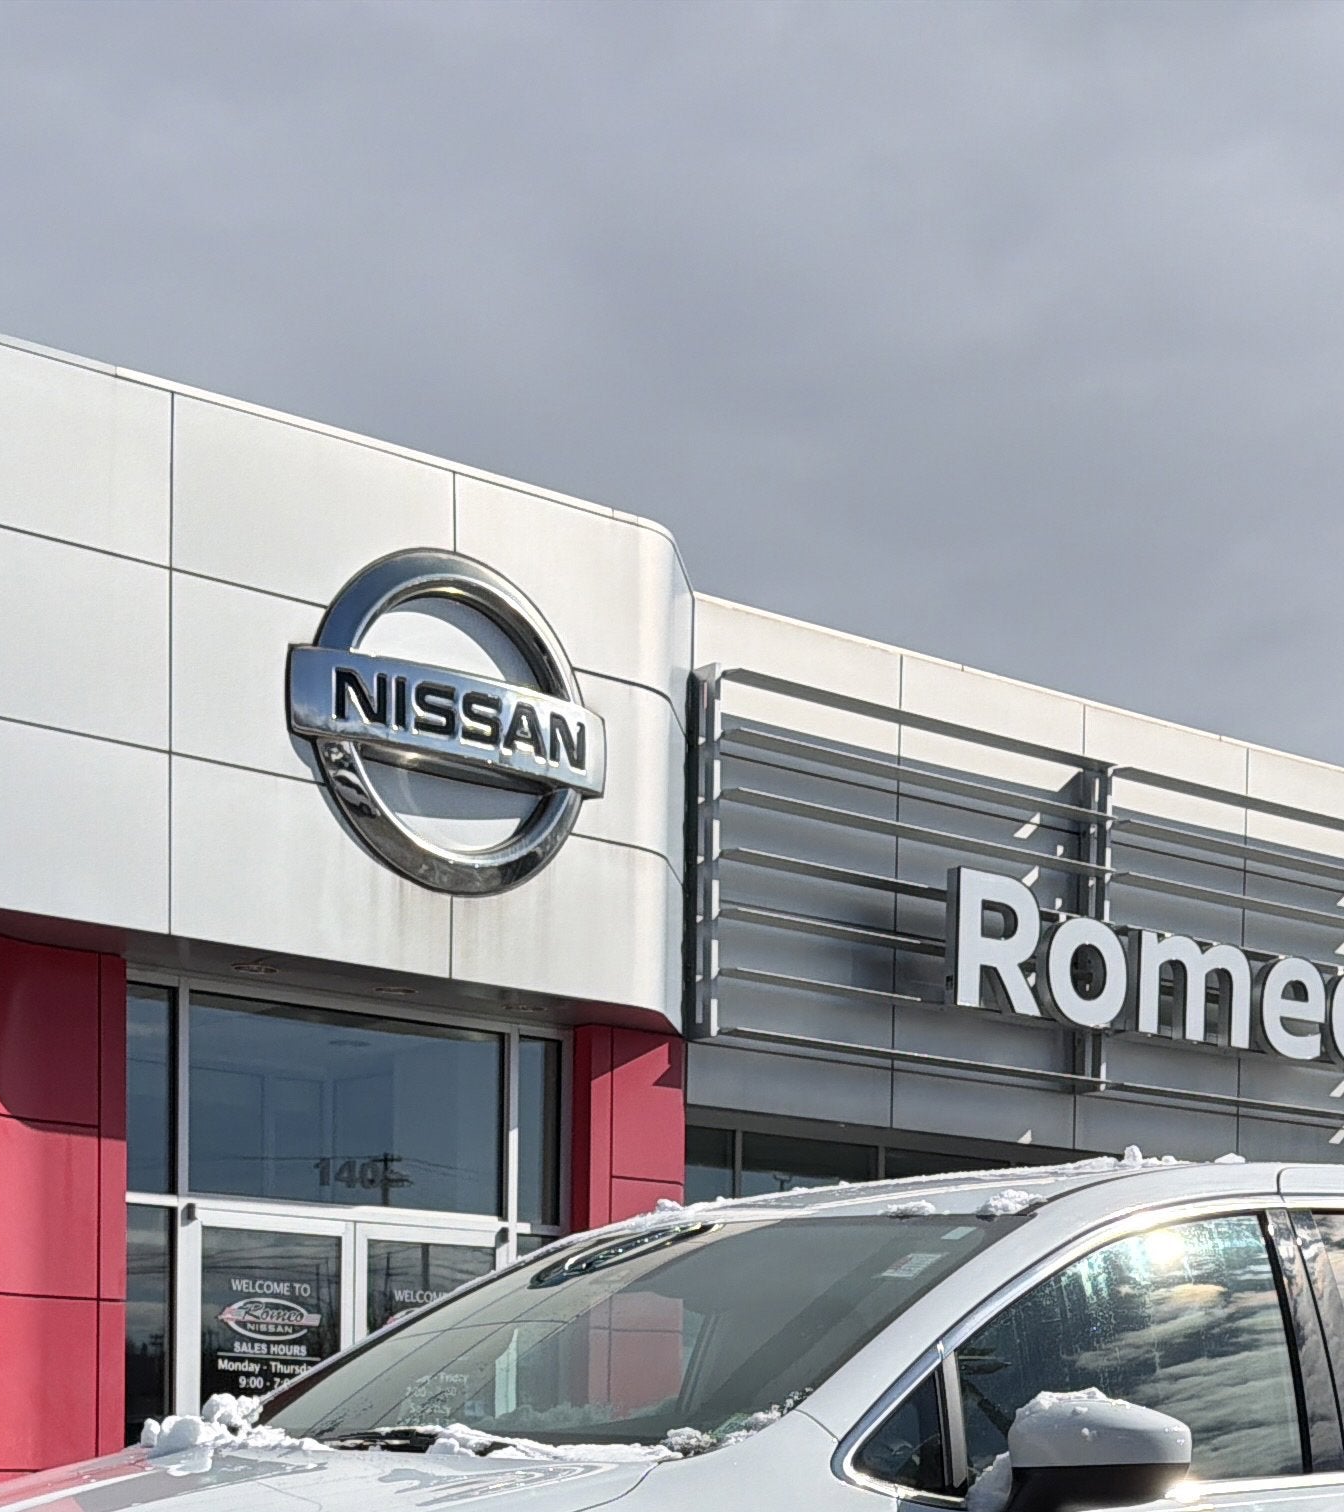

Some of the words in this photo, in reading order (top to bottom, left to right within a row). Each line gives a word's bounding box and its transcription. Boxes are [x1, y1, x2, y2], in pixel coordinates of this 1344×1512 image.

[331, 666, 588, 774] NISSAN
[231, 1278, 291, 1296] WELCOME
[293, 1281, 311, 1297] TO
[394, 1288, 446, 1304] WELCOM
[239, 1300, 305, 1323] Romeo
[246, 1323, 293, 1334] NISSAN
[233, 1341, 268, 1355] SALES
[269, 1343, 308, 1357] HOURS
[217, 1358, 261, 1375] Monday
[238, 1376, 264, 1389] 9:00
